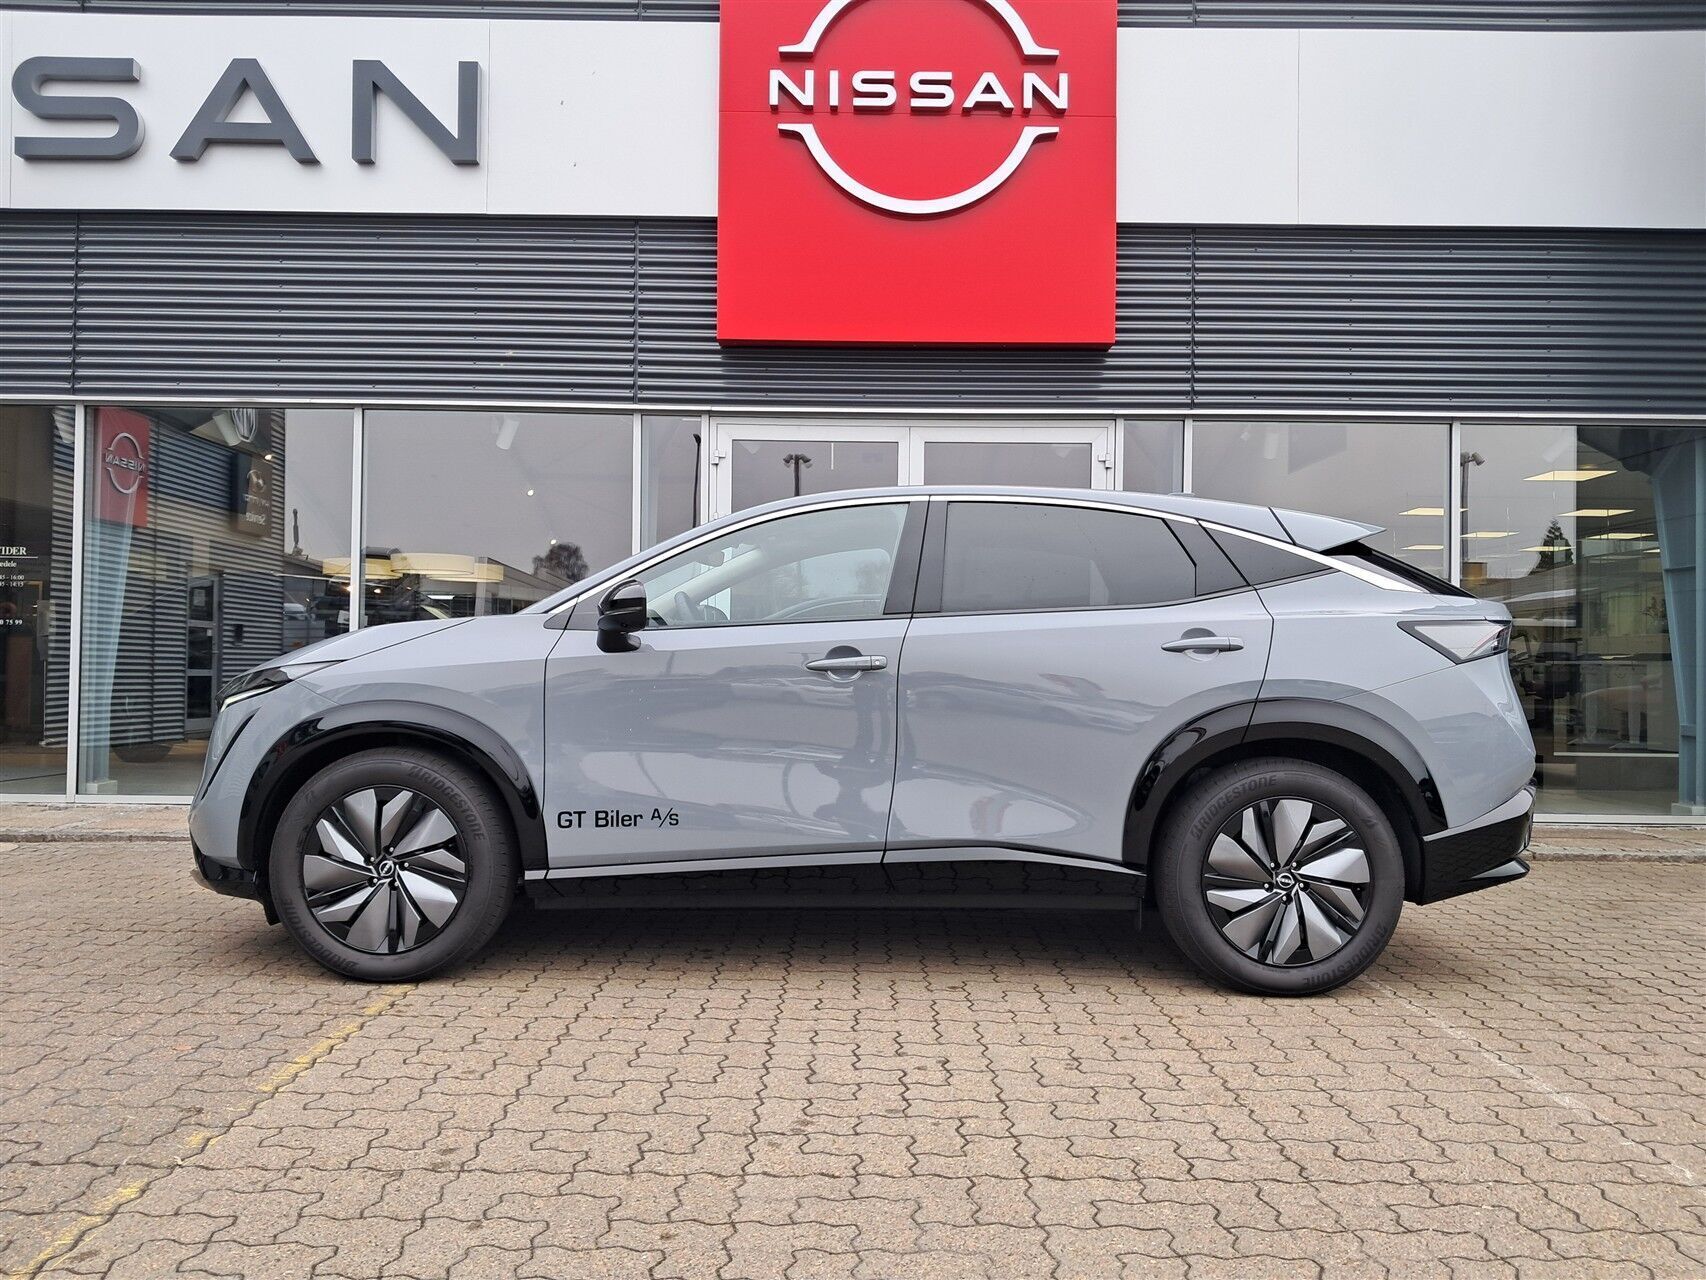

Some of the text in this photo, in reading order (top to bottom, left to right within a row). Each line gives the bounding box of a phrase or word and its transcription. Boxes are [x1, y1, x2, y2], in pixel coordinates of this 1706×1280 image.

[12, 56, 481, 166] SAN
[769, 69, 1069, 114] NISSAN
[408, 765, 486, 841] BRIDGESTONE
[557, 810, 587, 828] GT
[594, 809, 643, 828] Biler
[1191, 775, 1278, 840] BRIDGESTONE
